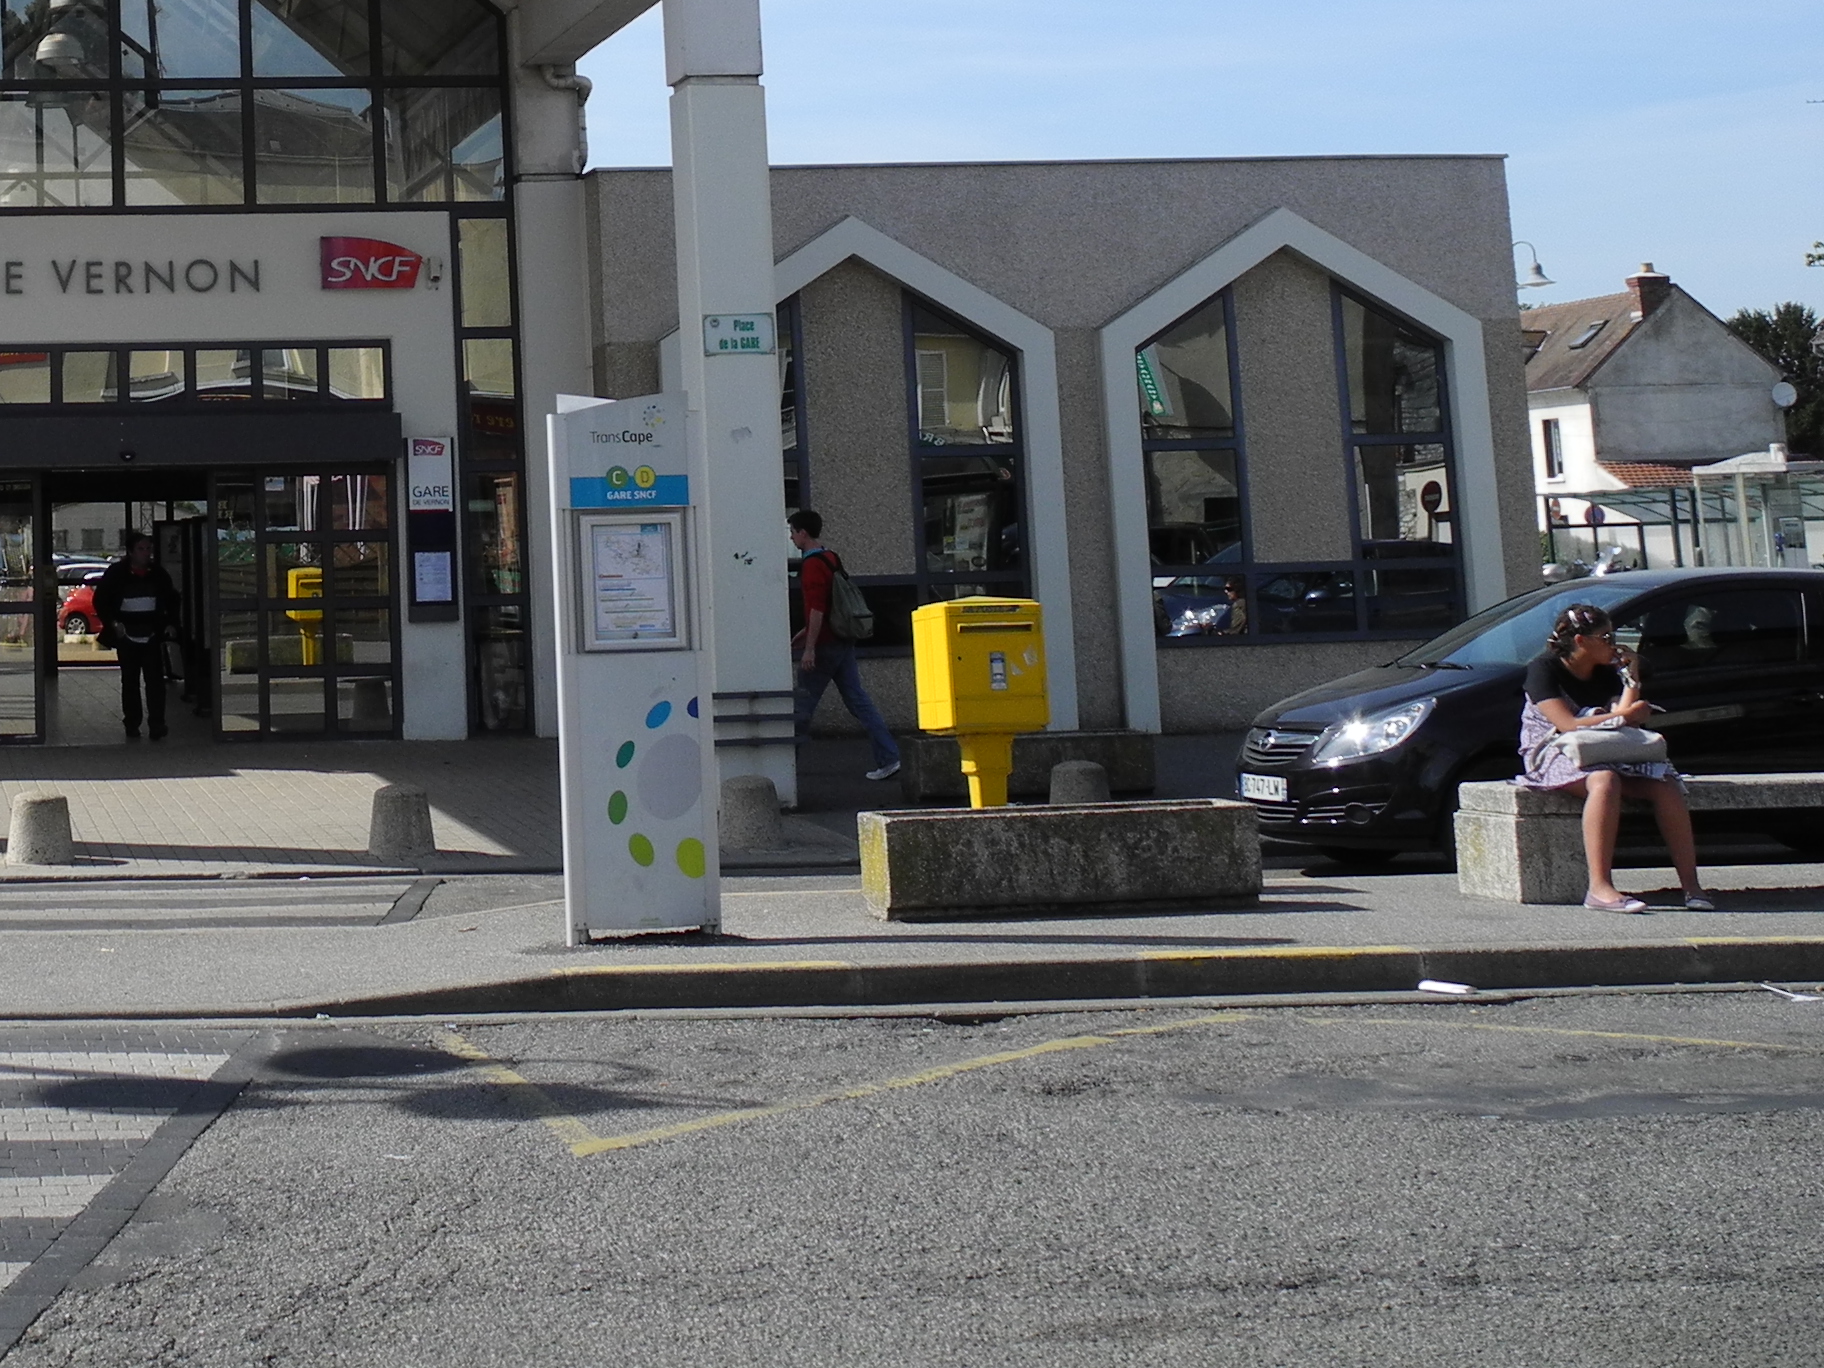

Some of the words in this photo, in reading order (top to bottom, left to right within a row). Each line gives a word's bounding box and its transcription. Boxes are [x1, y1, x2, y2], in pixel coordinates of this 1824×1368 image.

[327, 255, 415, 282] SNCF
[50, 259, 261, 294] VERNON
[733, 319, 755, 332] Place
[719, 338, 728, 350] de
[730, 337, 738, 349] la
[740, 337, 760, 349] GARE
[589, 430, 654, 445] TransCape
[415, 445, 443, 455] SNCF
[612, 470, 622, 485] C
[640, 470, 650, 484] D
[412, 485, 450, 499] GARE
[606, 491, 632, 500] GARE
[634, 490, 657, 500] SNCF
